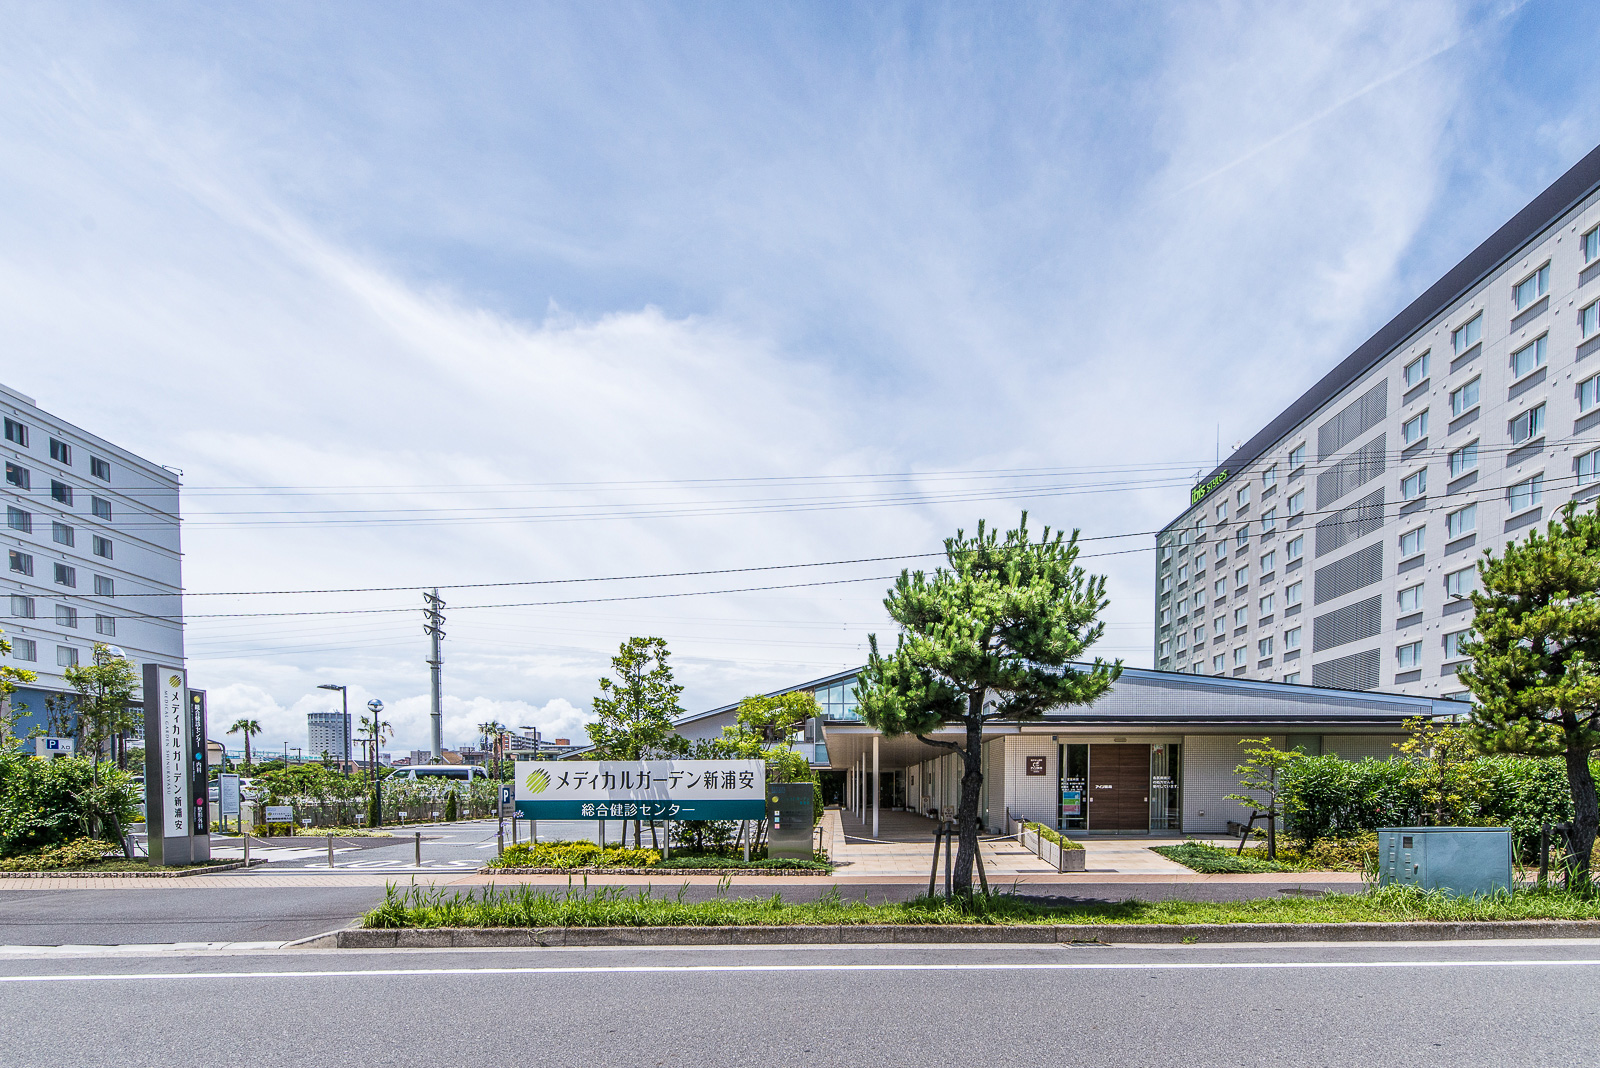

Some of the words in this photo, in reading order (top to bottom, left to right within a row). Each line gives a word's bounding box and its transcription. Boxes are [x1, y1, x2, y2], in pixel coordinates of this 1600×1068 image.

[1191, 484, 1206, 505] ibis
[49, 740, 57, 749] P
[171, 691, 184, 830] メディカルガーデン新浦安
[556, 770, 755, 791] メディカルガーデン新浦安
[503, 789, 509, 802] P
[581, 803, 695, 817] 総合健診センター
[304, 859, 482, 868] STOP
